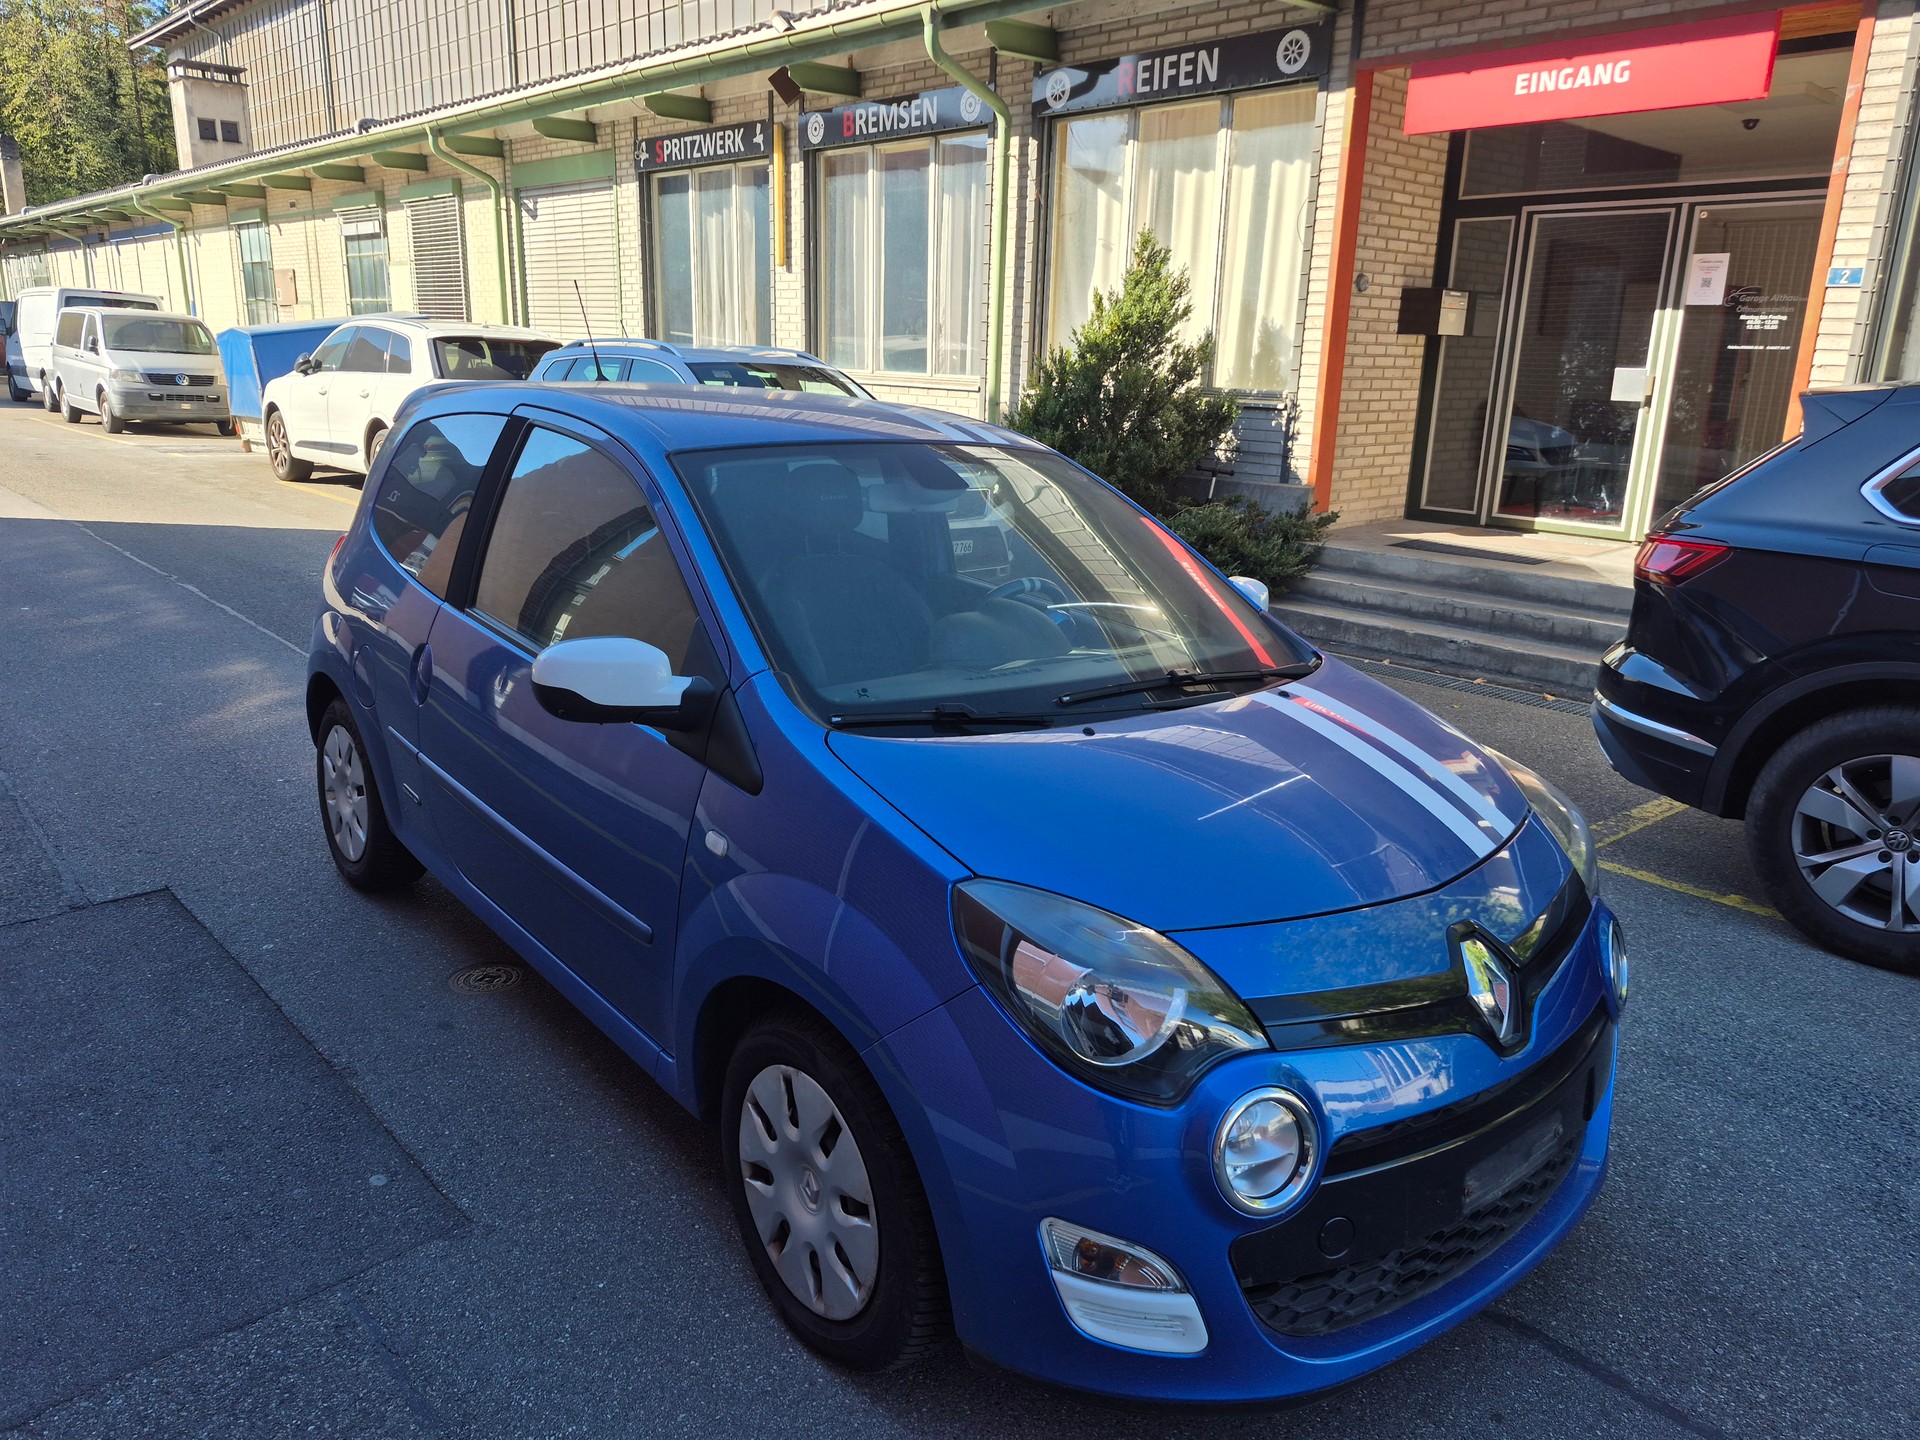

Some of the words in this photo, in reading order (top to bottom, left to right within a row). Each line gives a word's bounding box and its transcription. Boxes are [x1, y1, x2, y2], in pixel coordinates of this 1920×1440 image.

[1118, 47, 1219, 96] REIFEN
[1514, 60, 1631, 95] EINGANG
[843, 96, 938, 137] BREMSEN
[655, 128, 745, 163] SPRITZWERK
[1839, 270, 1850, 283] 2
